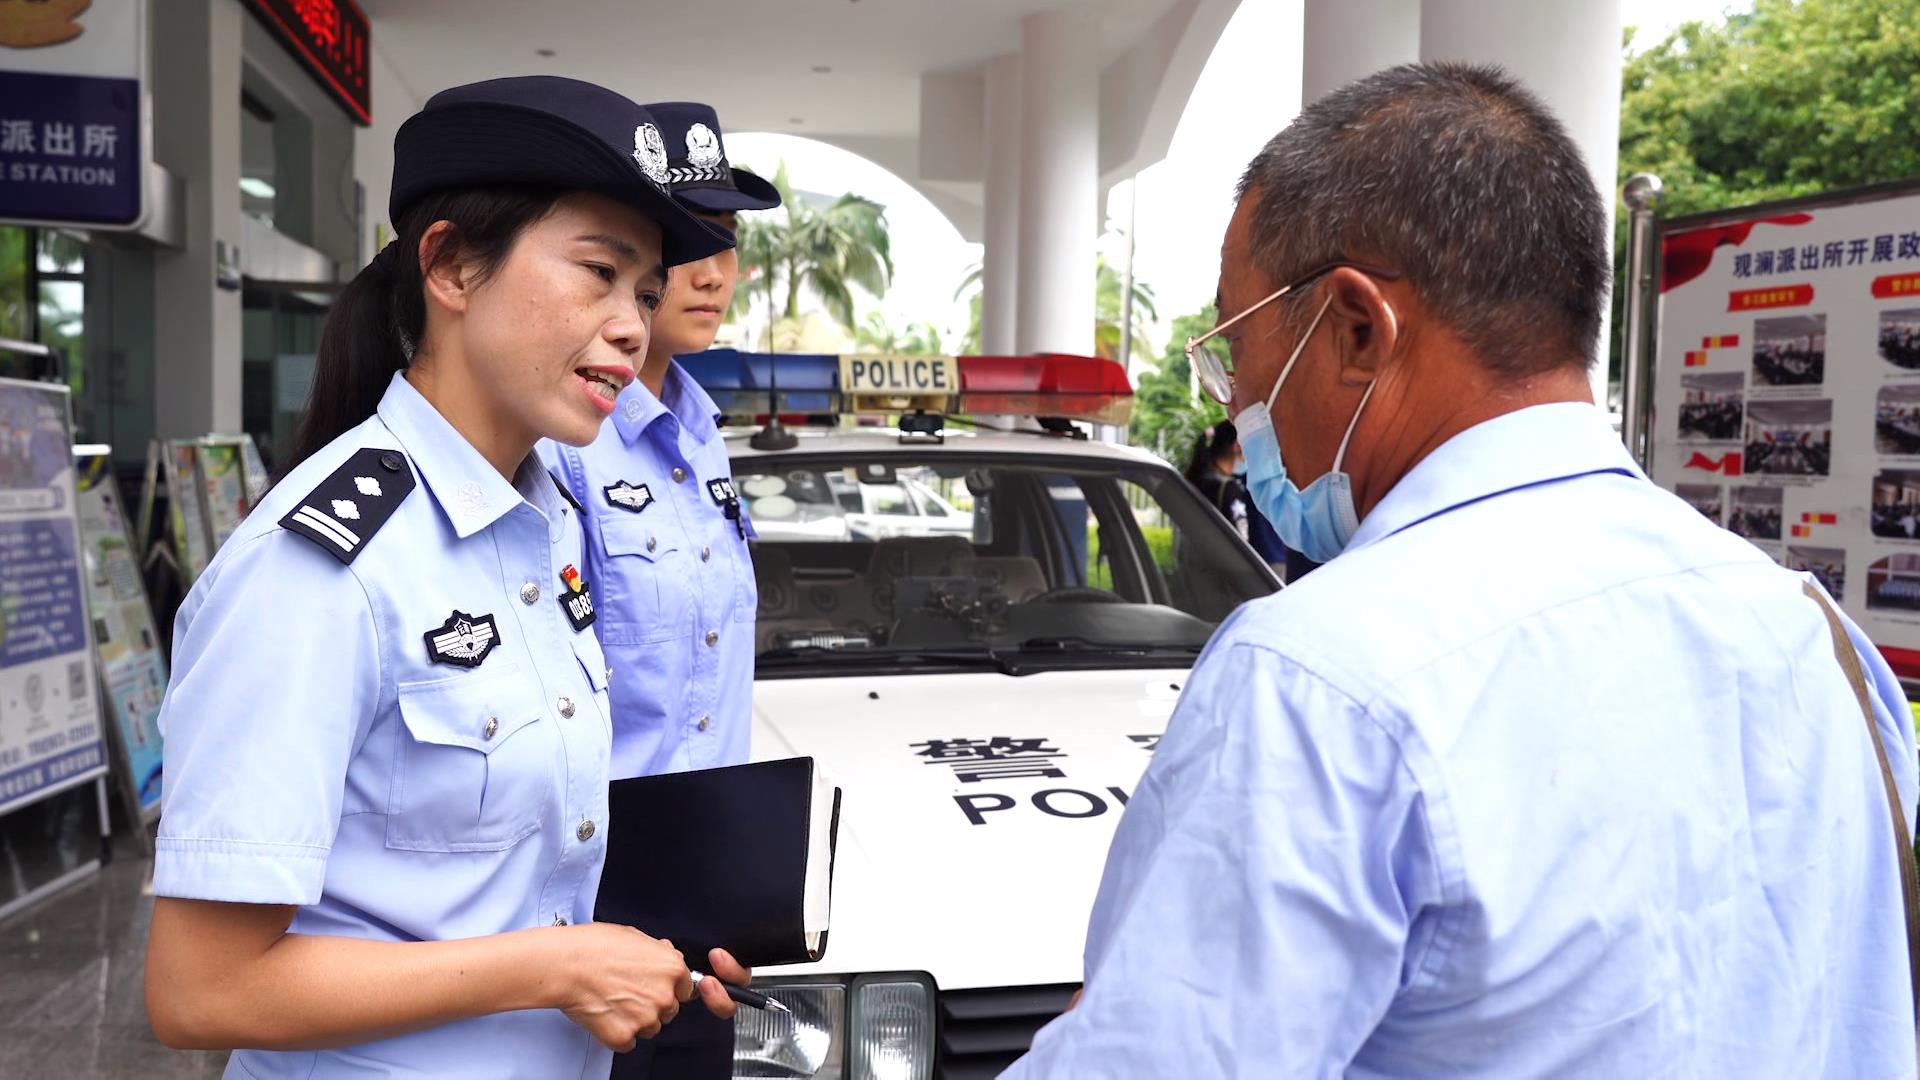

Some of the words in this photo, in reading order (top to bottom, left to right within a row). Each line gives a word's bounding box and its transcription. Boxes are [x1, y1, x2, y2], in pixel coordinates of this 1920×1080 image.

[1, 119, 119, 159] 派出所
[10, 162, 116, 186] STATION
[852, 360, 945, 387] POLICE
